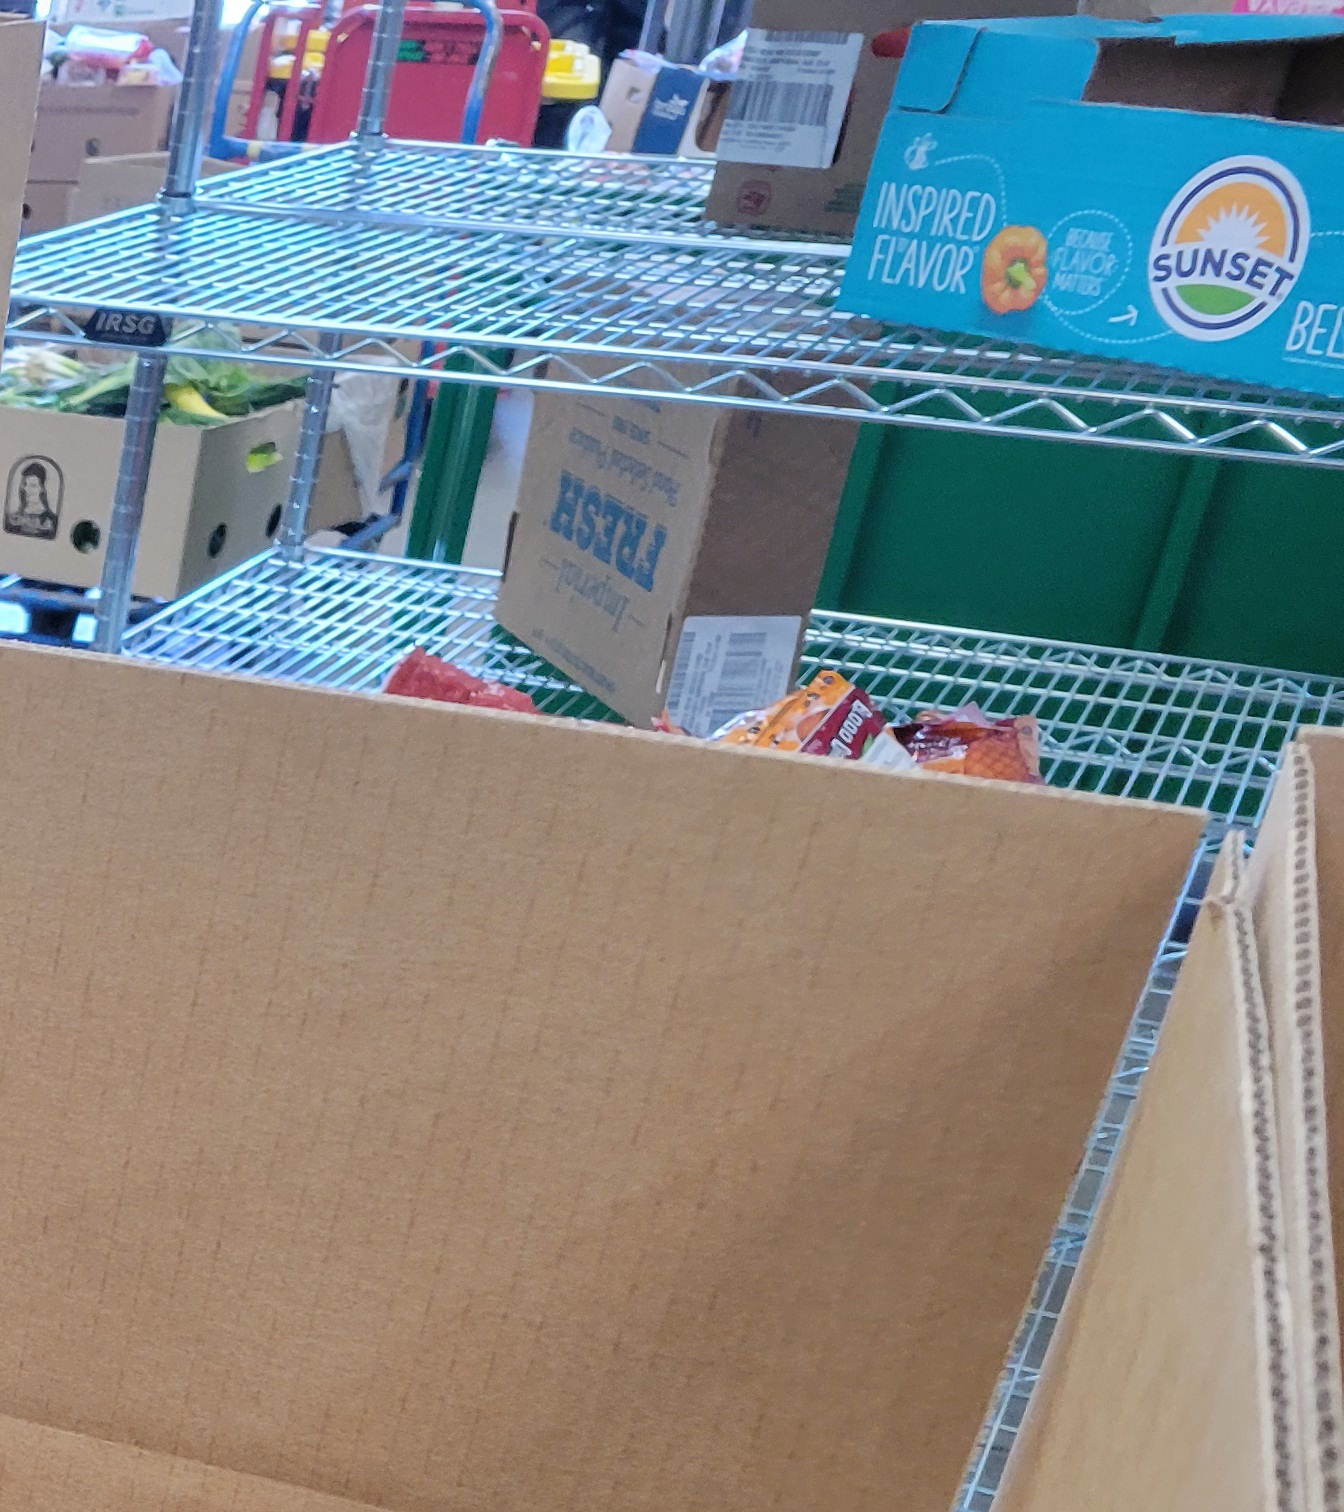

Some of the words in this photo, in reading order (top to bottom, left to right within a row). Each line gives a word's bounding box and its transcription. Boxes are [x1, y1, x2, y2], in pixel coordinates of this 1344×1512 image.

[872, 181, 996, 242] INSPIRED
[867, 234, 974, 294] FLAVOR
[1152, 248, 1294, 297] SUNSET
[549, 469, 668, 592] FRESH
